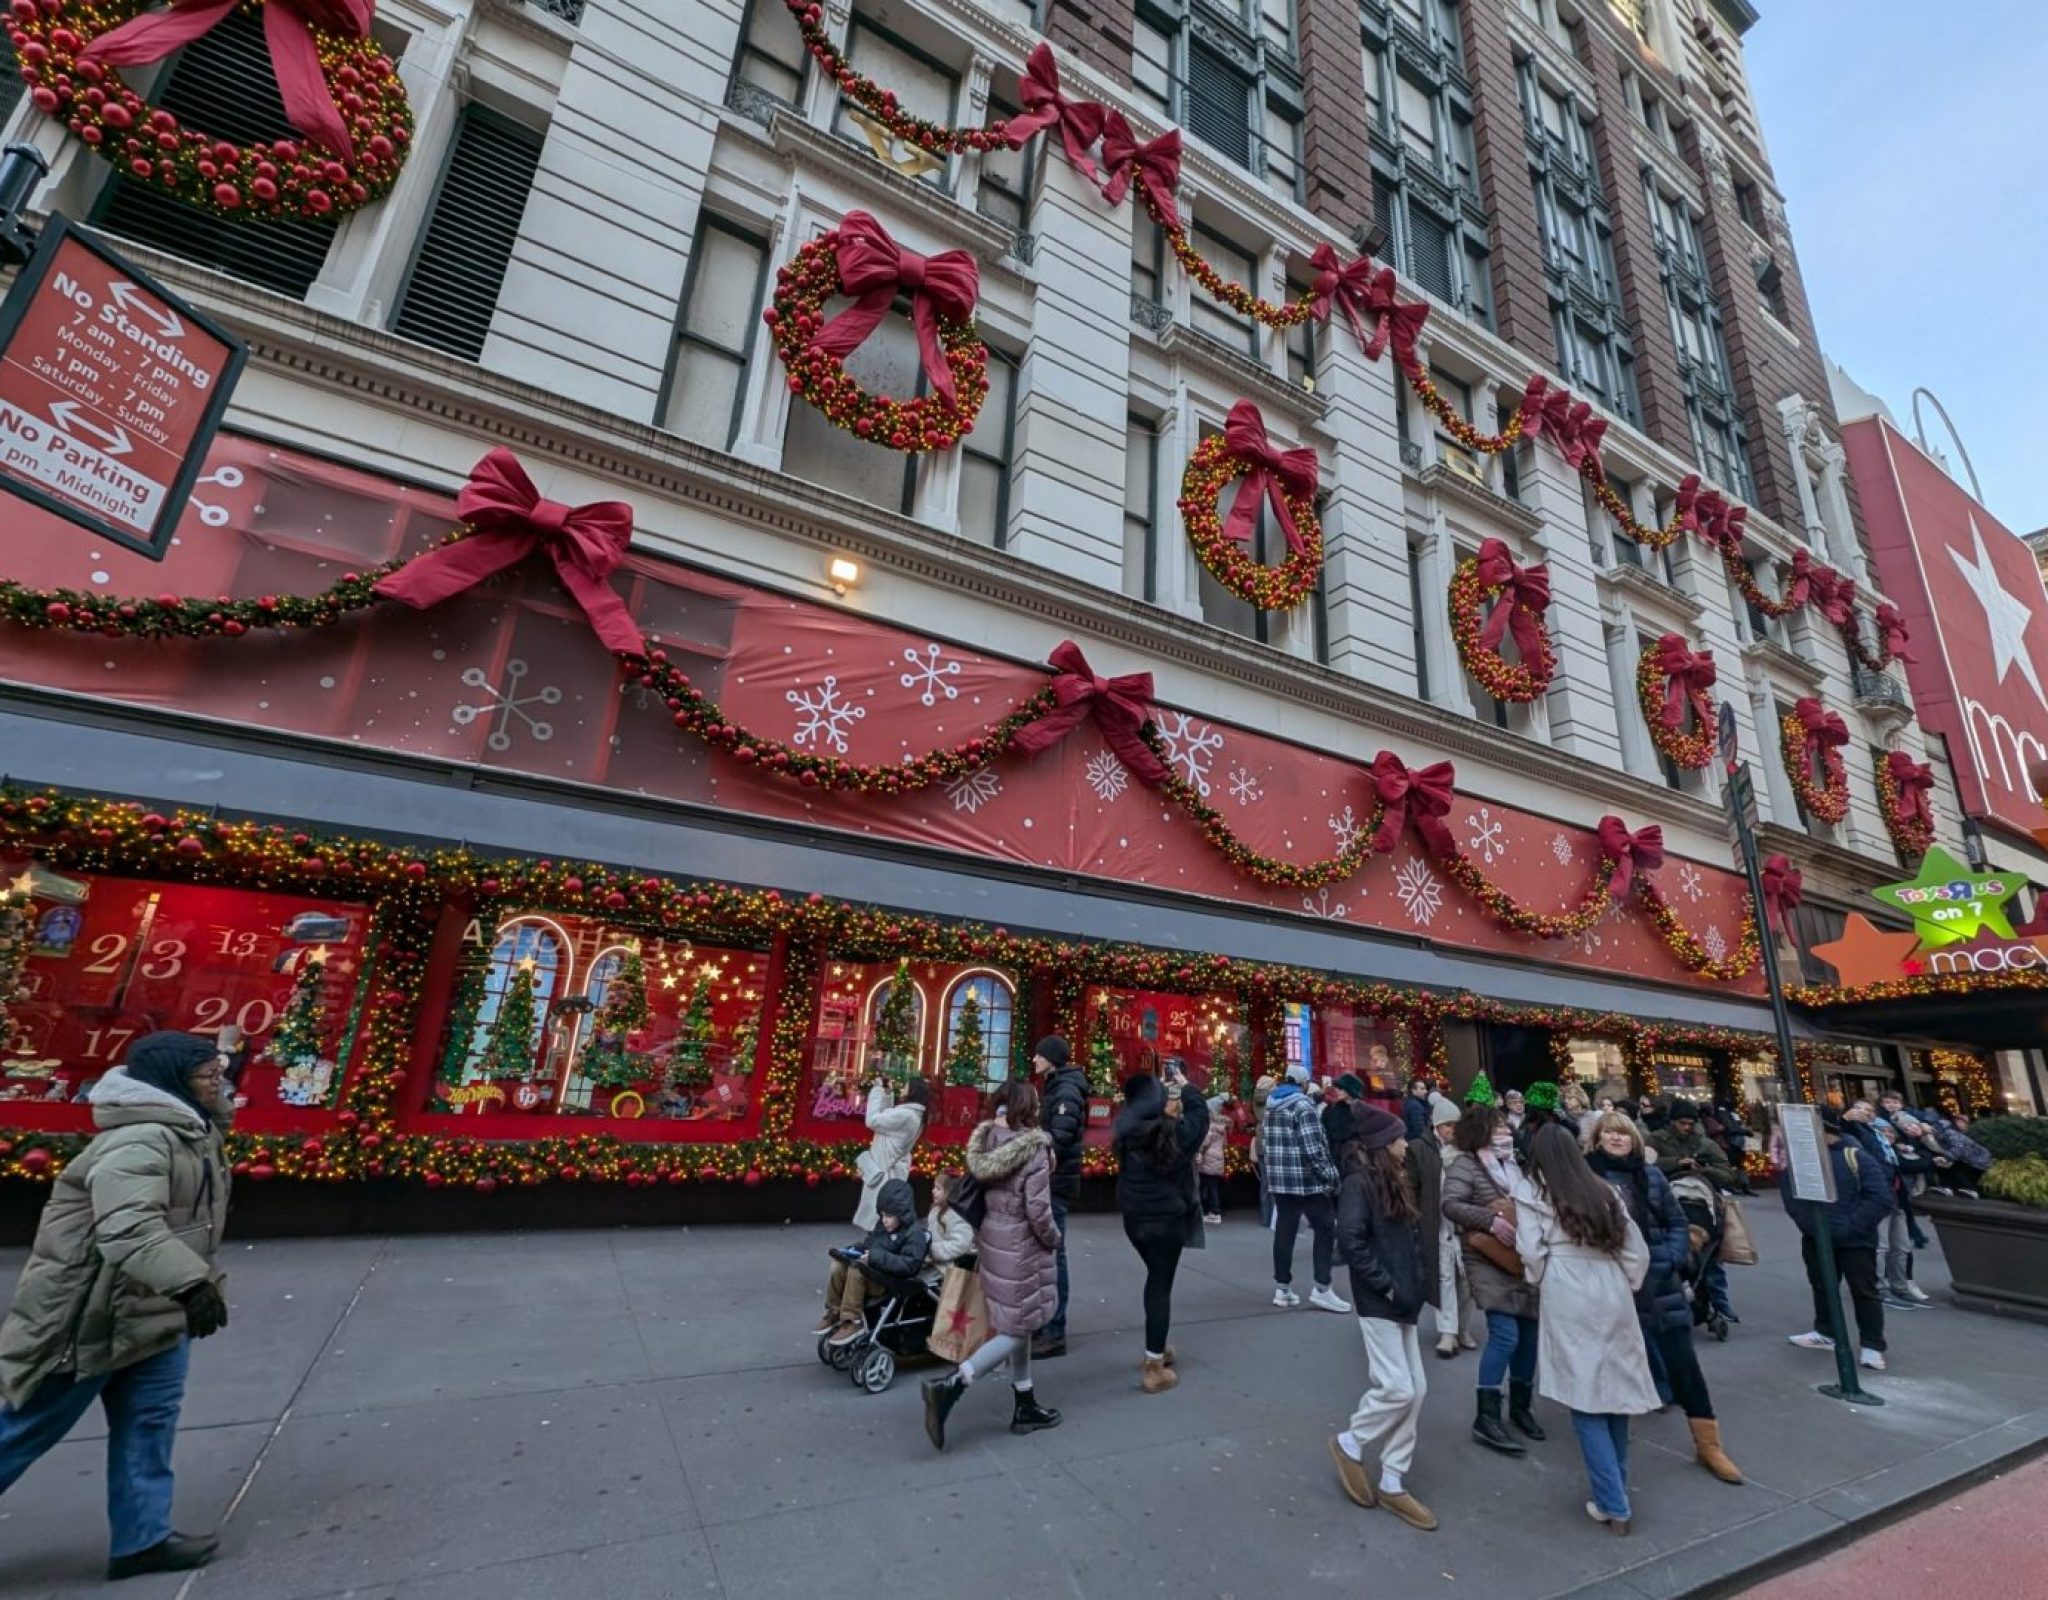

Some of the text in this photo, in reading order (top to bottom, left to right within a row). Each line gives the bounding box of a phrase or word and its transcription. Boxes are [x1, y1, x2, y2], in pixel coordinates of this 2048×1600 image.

[53, 272, 210, 389] No Standing
[72, 311, 86, 325] 7
[87, 325, 115, 348] am
[139, 354, 152, 368] 7
[152, 366, 180, 389] pm
[56, 347, 66, 361] 1
[68, 358, 100, 382] pm
[124, 388, 136, 401] 7
[137, 399, 165, 422] pm
[57, 325, 121, 373] Monday
[133, 372, 177, 408] Friday
[32, 356, 104, 405] Saturday
[116, 405, 170, 444] Sunday
[0, 408, 150, 504] No Parking
[6, 448, 39, 471] pm
[56, 469, 138, 521] Midnight
[1932, 902, 1983, 920] on 7
[217, 930, 258, 956] 13
[188, 997, 274, 1035] 20
[1113, 1014, 1131, 1031] 16
[1170, 1010, 1188, 1026] 25
[80, 1027, 134, 1061] 17
[519, 1086, 536, 1106] fp
